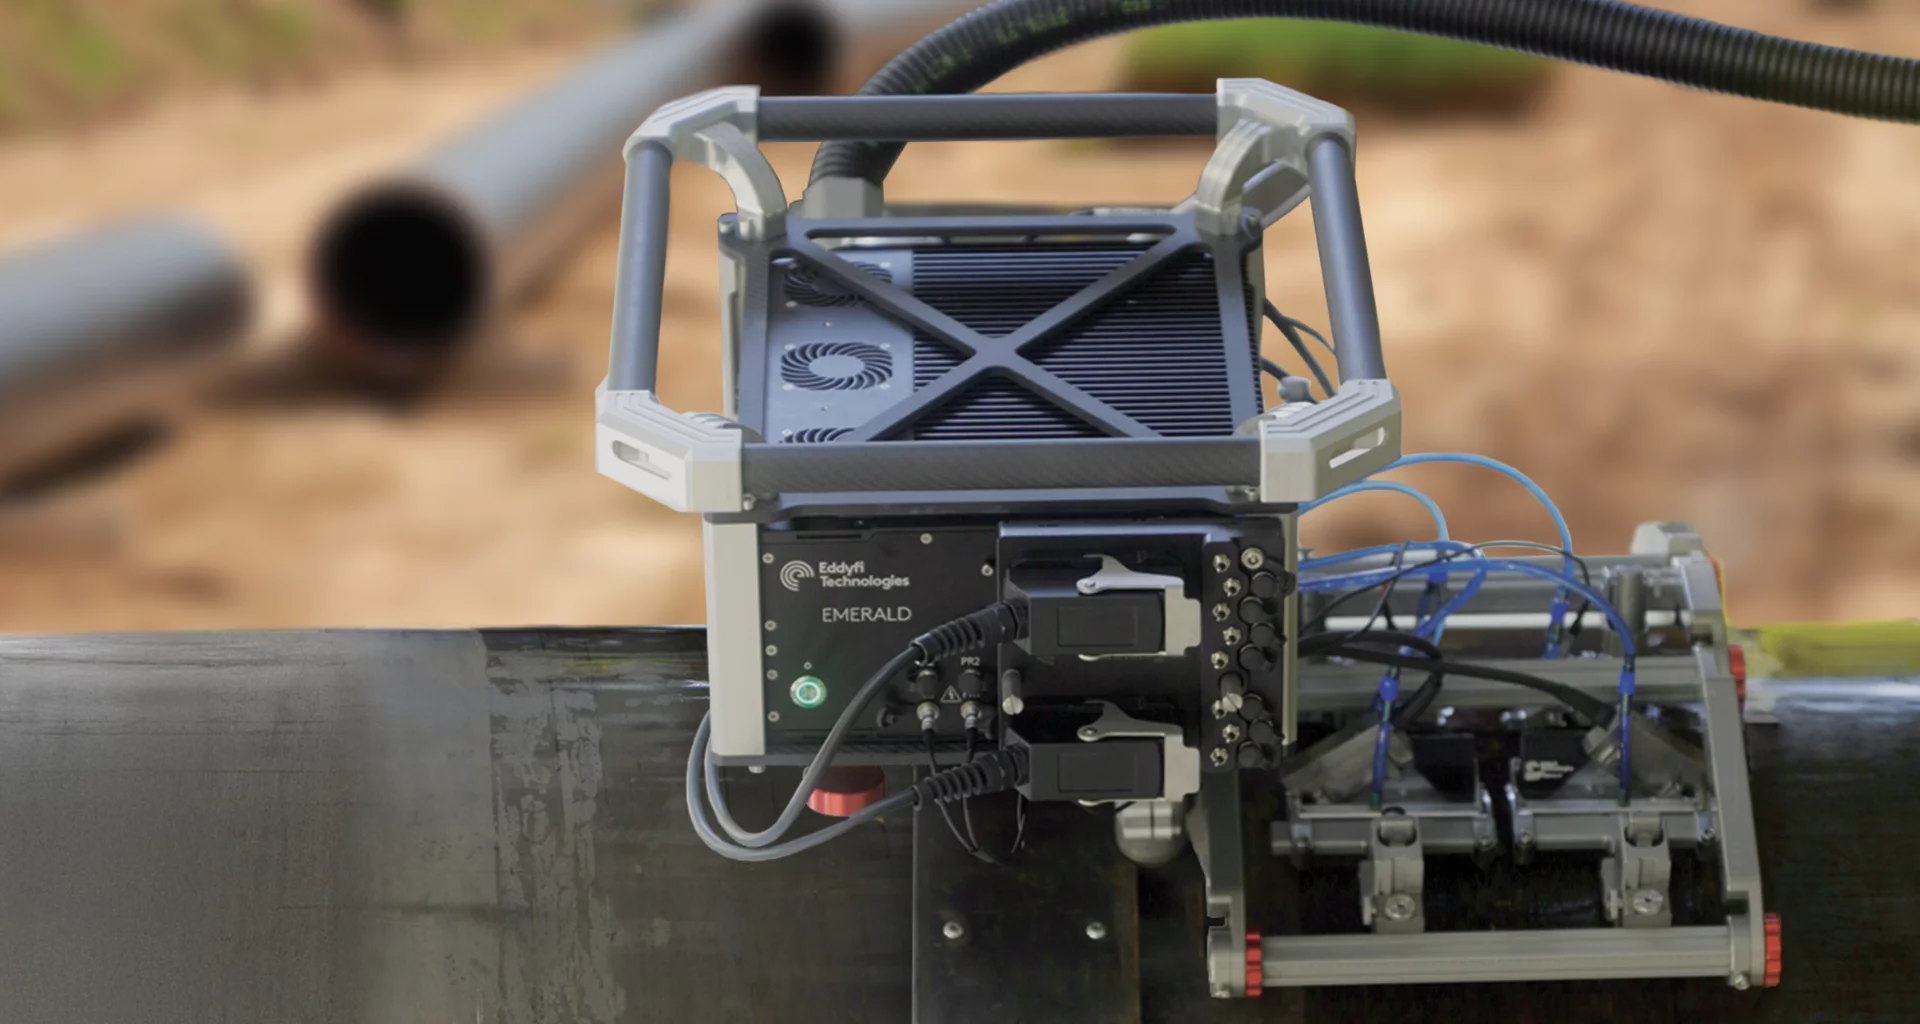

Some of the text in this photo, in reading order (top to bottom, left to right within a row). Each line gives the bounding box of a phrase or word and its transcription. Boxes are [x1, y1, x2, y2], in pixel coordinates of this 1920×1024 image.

[819, 561, 866, 577] Eddyfi
[820, 574, 911, 590] Technologies
[822, 606, 912, 622] EMERALD
[961, 656, 980, 666] PR2
